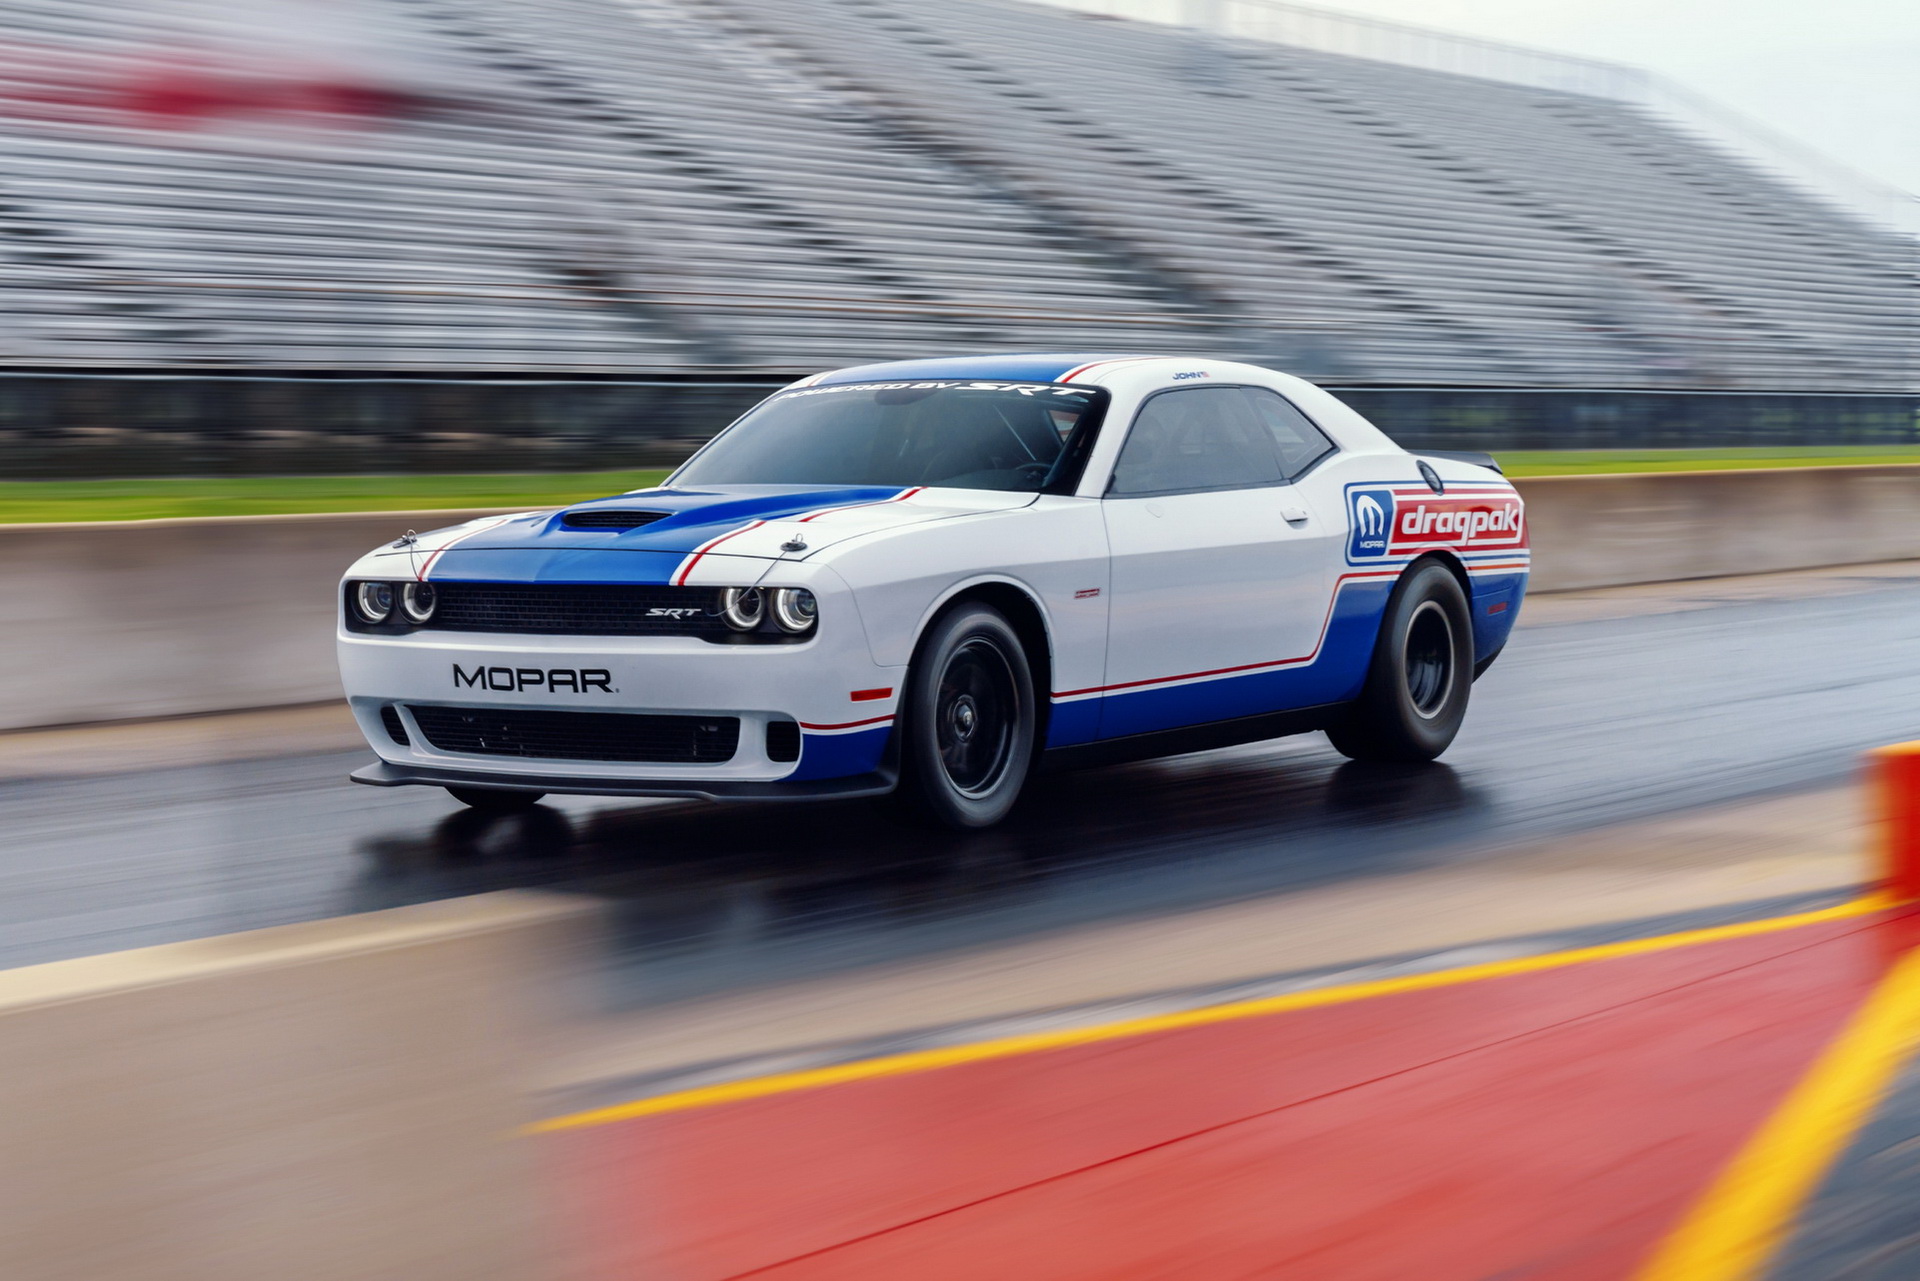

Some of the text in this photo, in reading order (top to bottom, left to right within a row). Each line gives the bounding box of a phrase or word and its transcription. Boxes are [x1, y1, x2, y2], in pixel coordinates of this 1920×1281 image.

[955, 382, 1097, 396] SRT
[1401, 502, 1519, 546] dragpak
[1359, 540, 1386, 549] MOPAR
[645, 608, 701, 620] SRT
[452, 663, 614, 693] MOPAR
